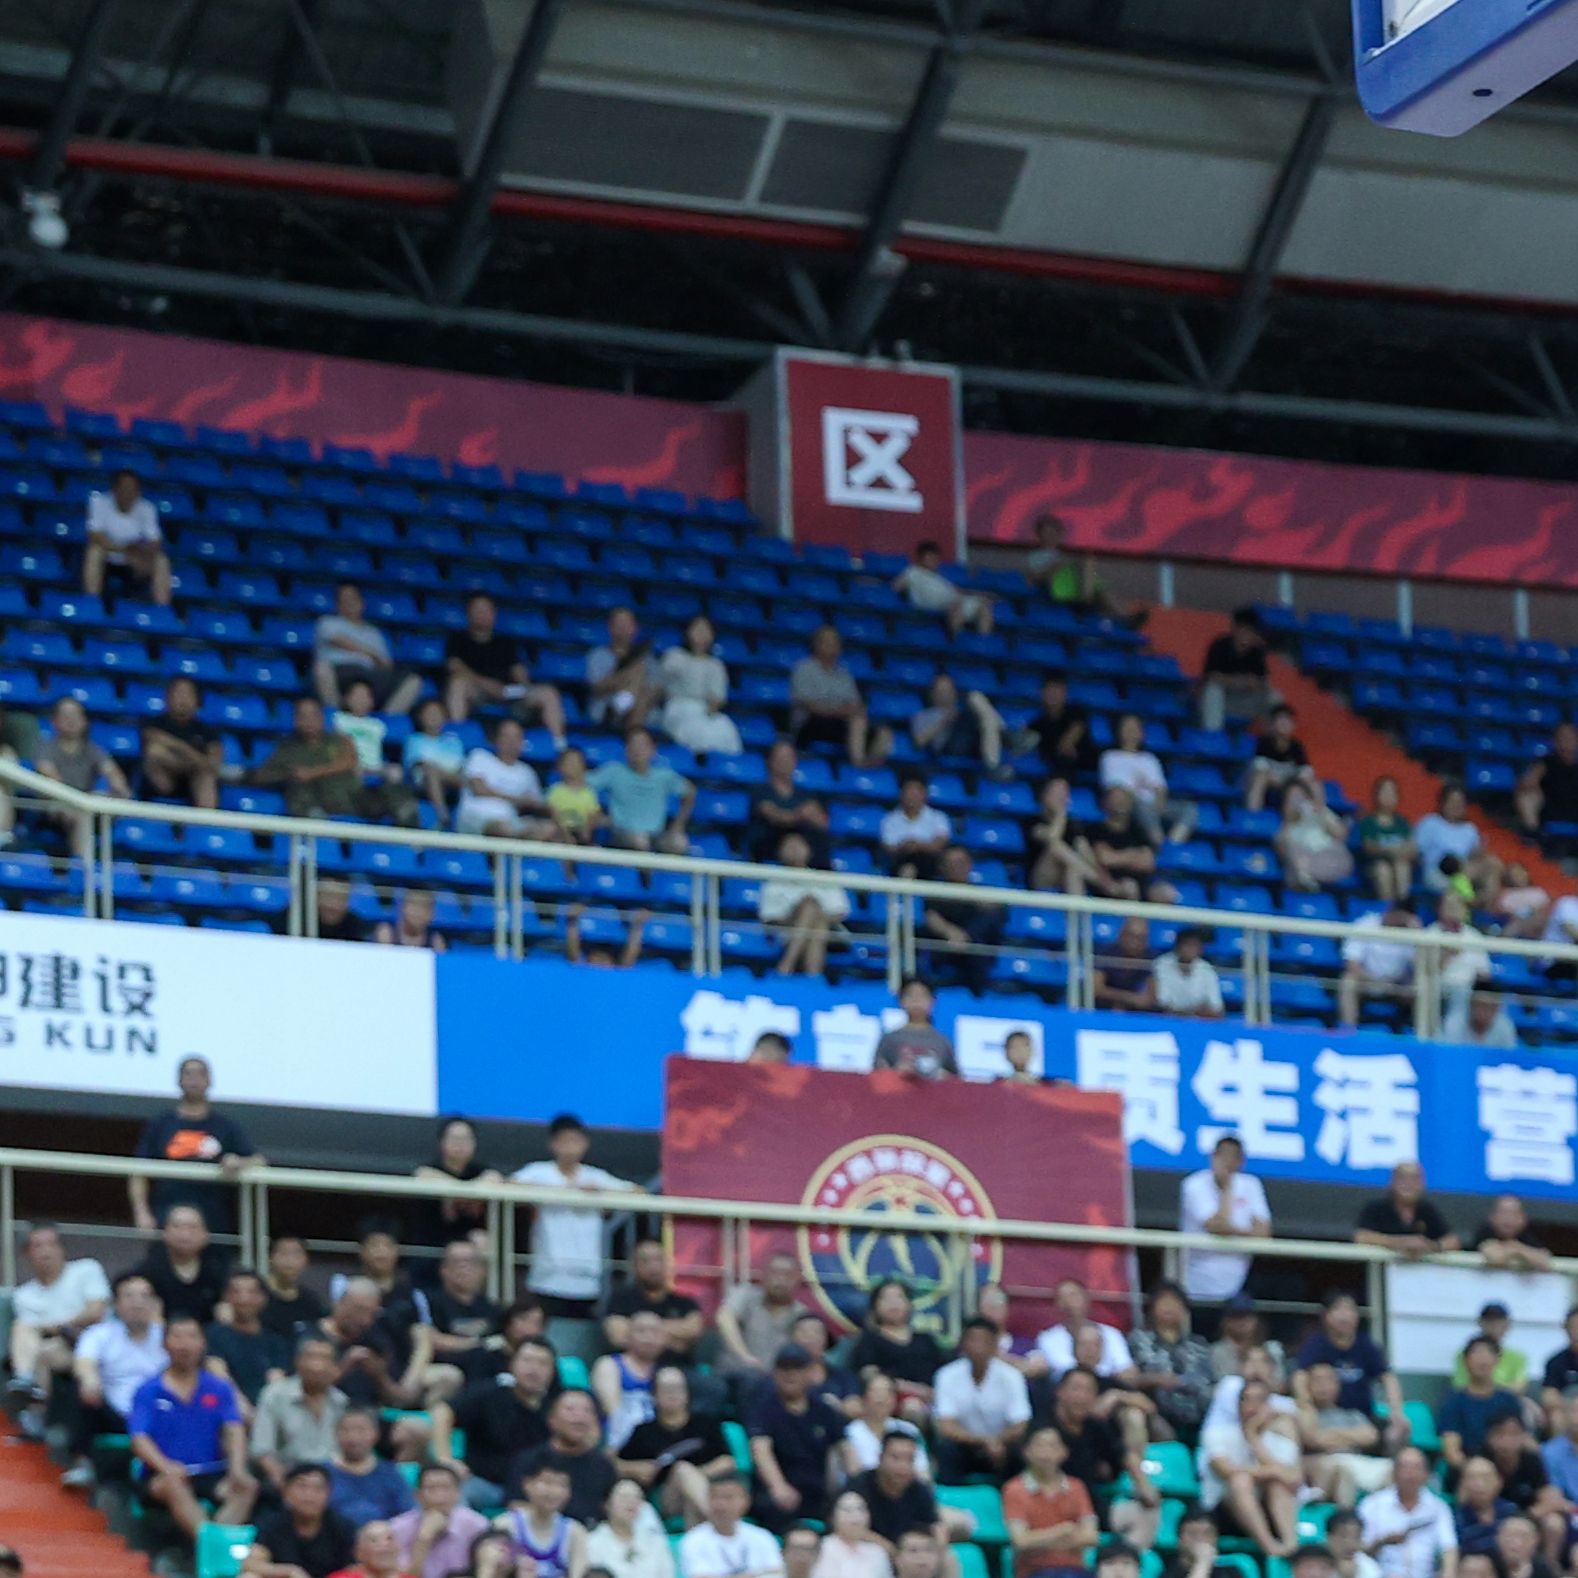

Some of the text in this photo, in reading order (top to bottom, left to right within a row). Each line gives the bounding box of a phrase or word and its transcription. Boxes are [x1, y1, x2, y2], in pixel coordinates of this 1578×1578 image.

[822, 405, 924, 514] 区
[0, 952, 155, 1016] 建设
[45, 1020, 158, 1053] KUN
